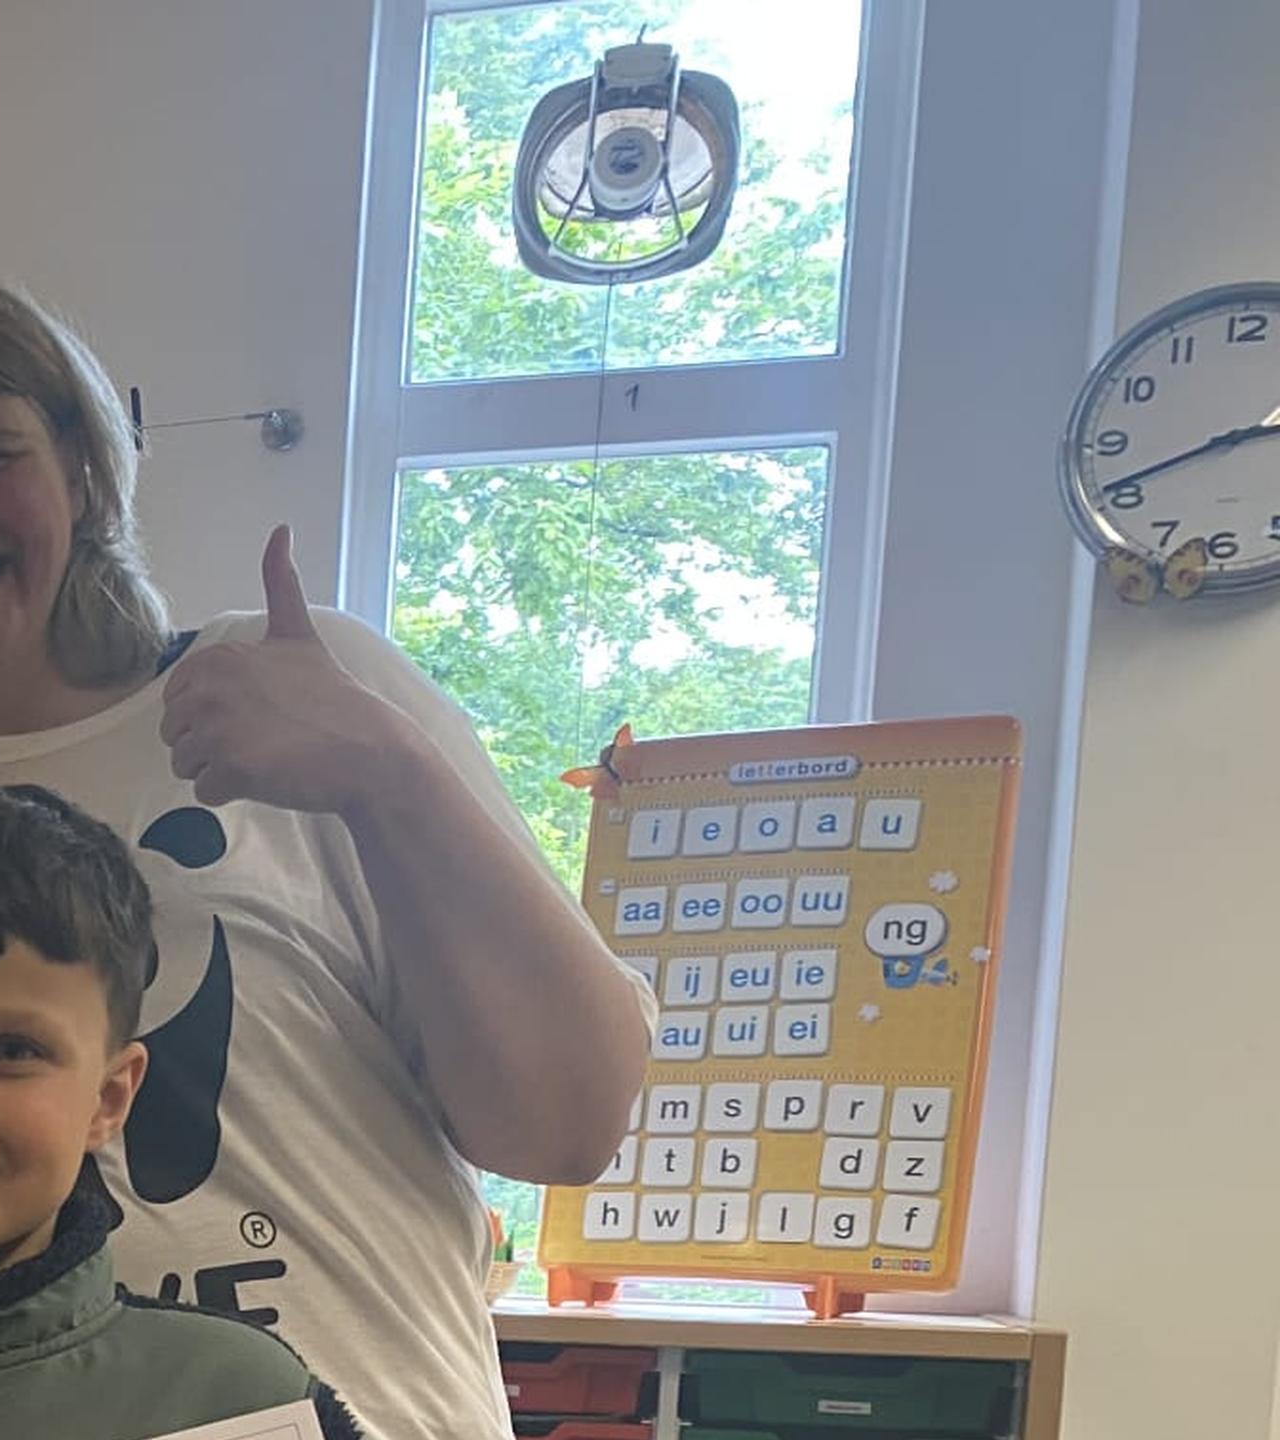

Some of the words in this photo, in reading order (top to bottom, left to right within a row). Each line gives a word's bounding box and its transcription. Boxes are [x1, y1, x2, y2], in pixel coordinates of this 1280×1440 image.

[1227, 315, 1268, 342] 12
[1171, 337, 1193, 364] 11
[1124, 376, 1155, 403] 10
[1096, 430, 1128, 456] 9
[1110, 484, 1144, 509] 8
[1151, 520, 1180, 547] 7
[1208, 532, 1238, 558] 6
[738, 759, 848, 779] letterbord
[651, 819, 659, 845] i
[702, 822, 720, 841] e
[759, 817, 779, 837] o
[817, 814, 837, 834] a
[881, 814, 901, 835] u
[623, 900, 661, 923] aa
[682, 896, 721, 918] ee
[741, 893, 782, 914] oo
[801, 890, 843, 912] uu
[883, 916, 928, 945] ng
[685, 966, 700, 997] ij
[730, 966, 769, 987] eu
[796, 963, 824, 986] ie
[662, 1026, 700, 1047] au
[728, 1016, 757, 1042] ui
[789, 1015, 817, 1040] ei
[660, 1100, 689, 1119] m
[724, 1097, 741, 1118] s
[784, 1094, 805, 1123] p
[850, 1100, 863, 1121] r
[912, 1102, 933, 1123] v
[665, 1148, 676, 1172] t
[721, 1146, 740, 1174] b
[840, 1149, 861, 1176] d
[905, 1156, 924, 1177] z
[602, 1201, 619, 1225] h
[654, 1206, 680, 1227] w
[716, 1202, 726, 1233] j
[834, 1210, 854, 1238] g
[905, 1206, 920, 1232] f
